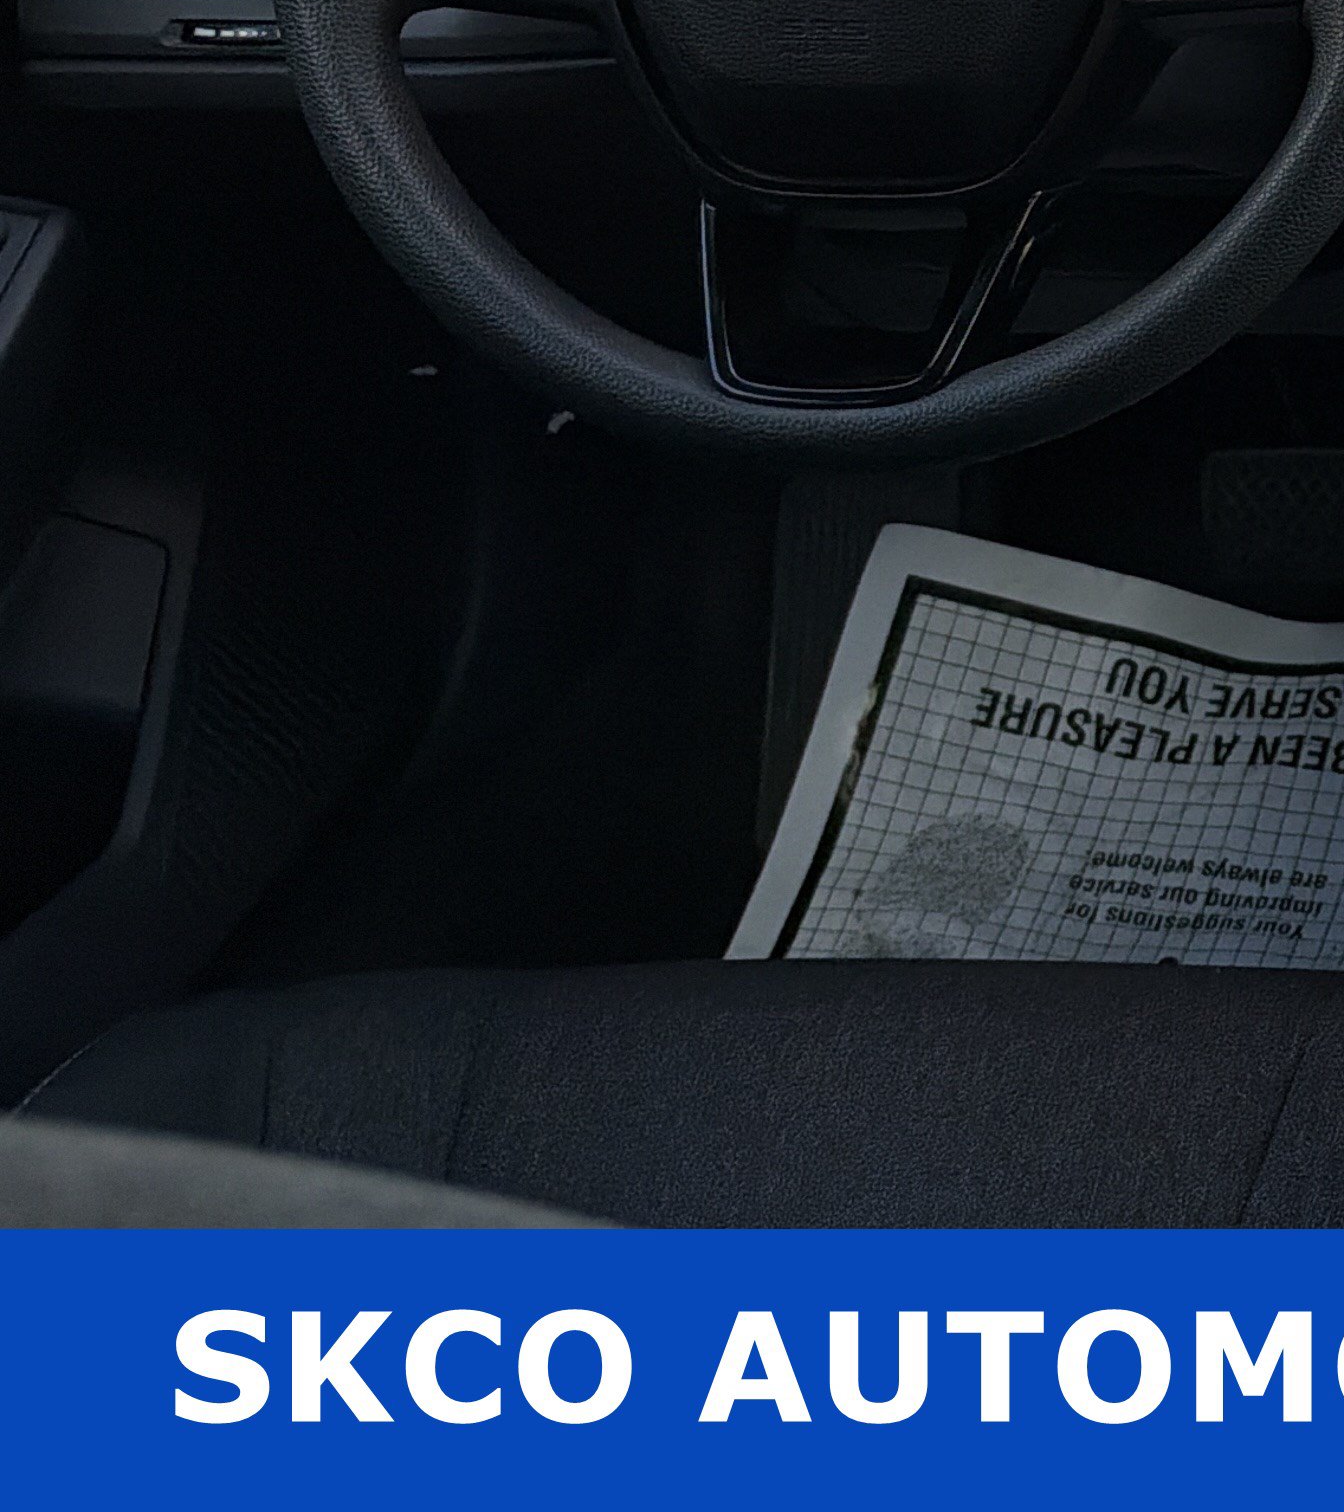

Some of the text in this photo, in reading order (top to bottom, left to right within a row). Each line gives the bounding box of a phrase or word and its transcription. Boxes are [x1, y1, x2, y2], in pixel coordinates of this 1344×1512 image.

[1106, 657, 1190, 716] YOU
[1206, 684, 1340, 721] SERVE
[970, 688, 1197, 765] PLEASURE
[1213, 735, 1237, 767] A
[1201, 857, 1283, 888] always
[1289, 871, 1329, 888] are
[1068, 874, 1324, 917] improving our service
[1064, 902, 1304, 940] Your suggestions for
